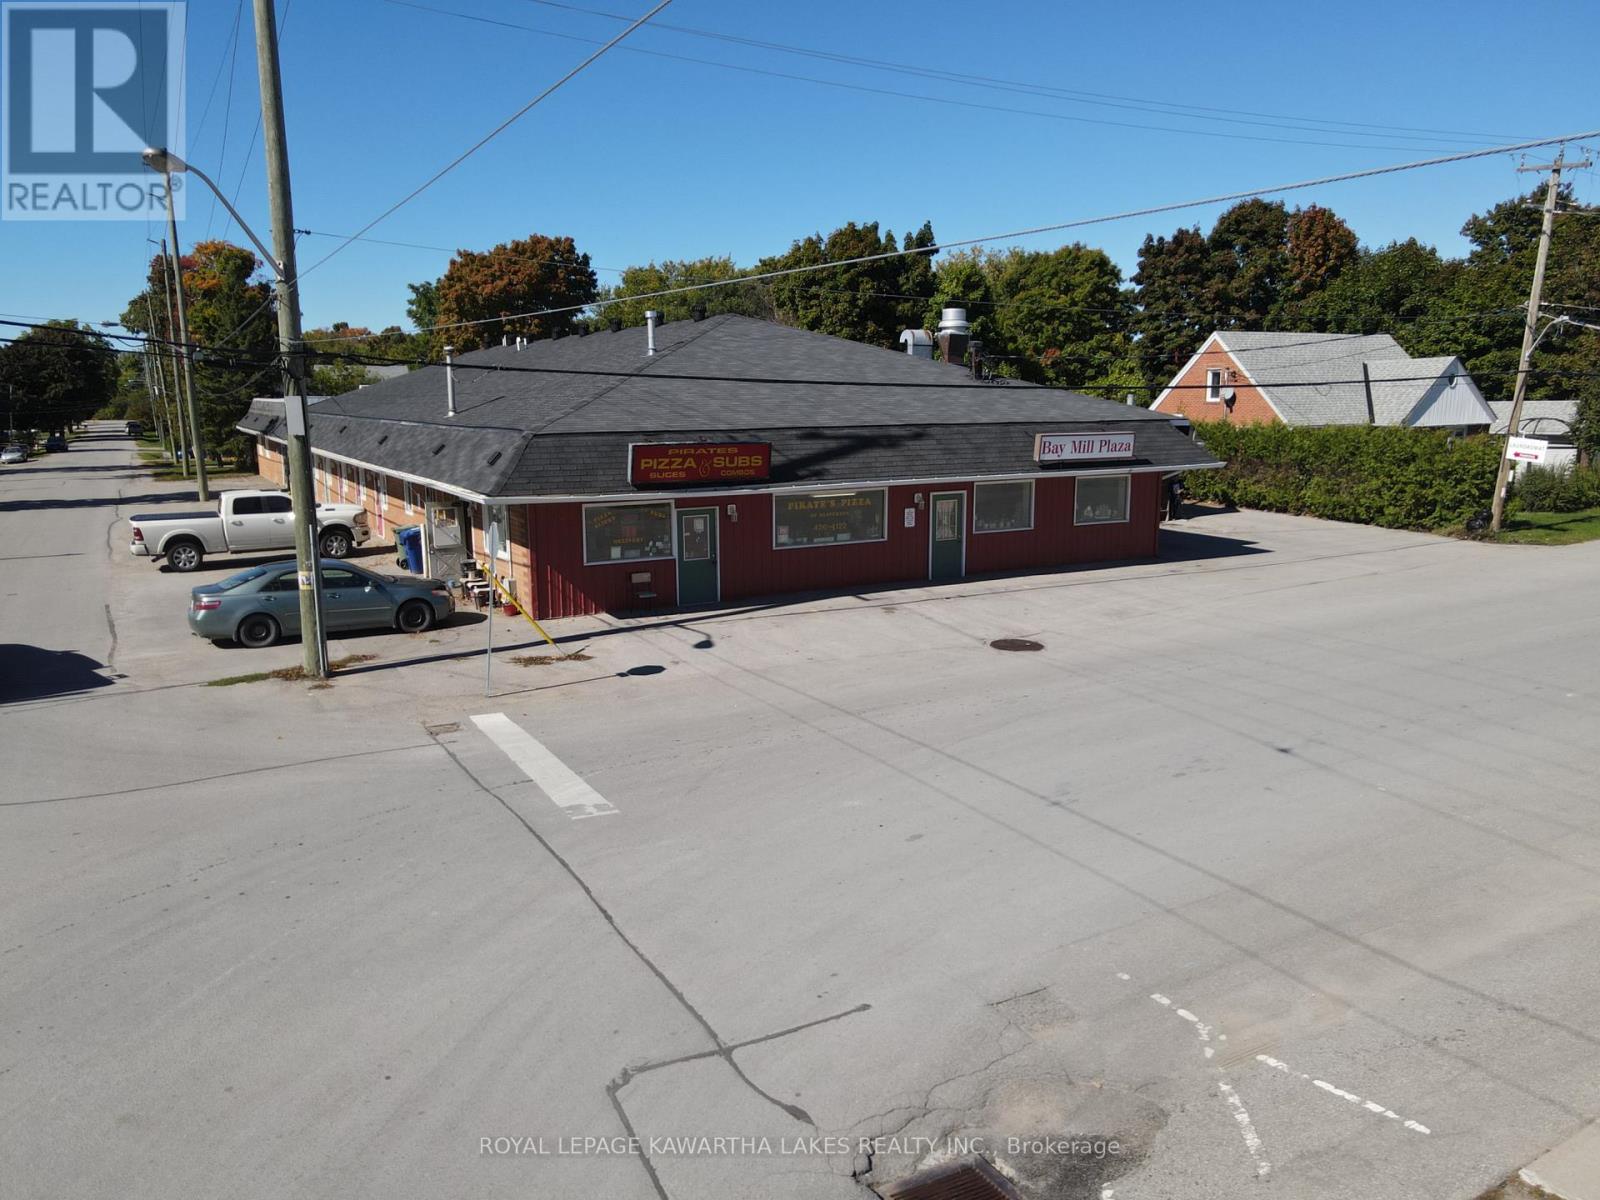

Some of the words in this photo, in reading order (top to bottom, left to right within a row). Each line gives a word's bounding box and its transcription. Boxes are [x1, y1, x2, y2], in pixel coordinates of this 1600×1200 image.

[667, 447, 738, 455] PIRATES
[1042, 440, 1066, 457] Bay
[1070, 440, 1094, 454] Mill
[1099, 439, 1131, 453] Plaza
[640, 457, 697, 470] PIZZA
[712, 455, 763, 468] SUBS
